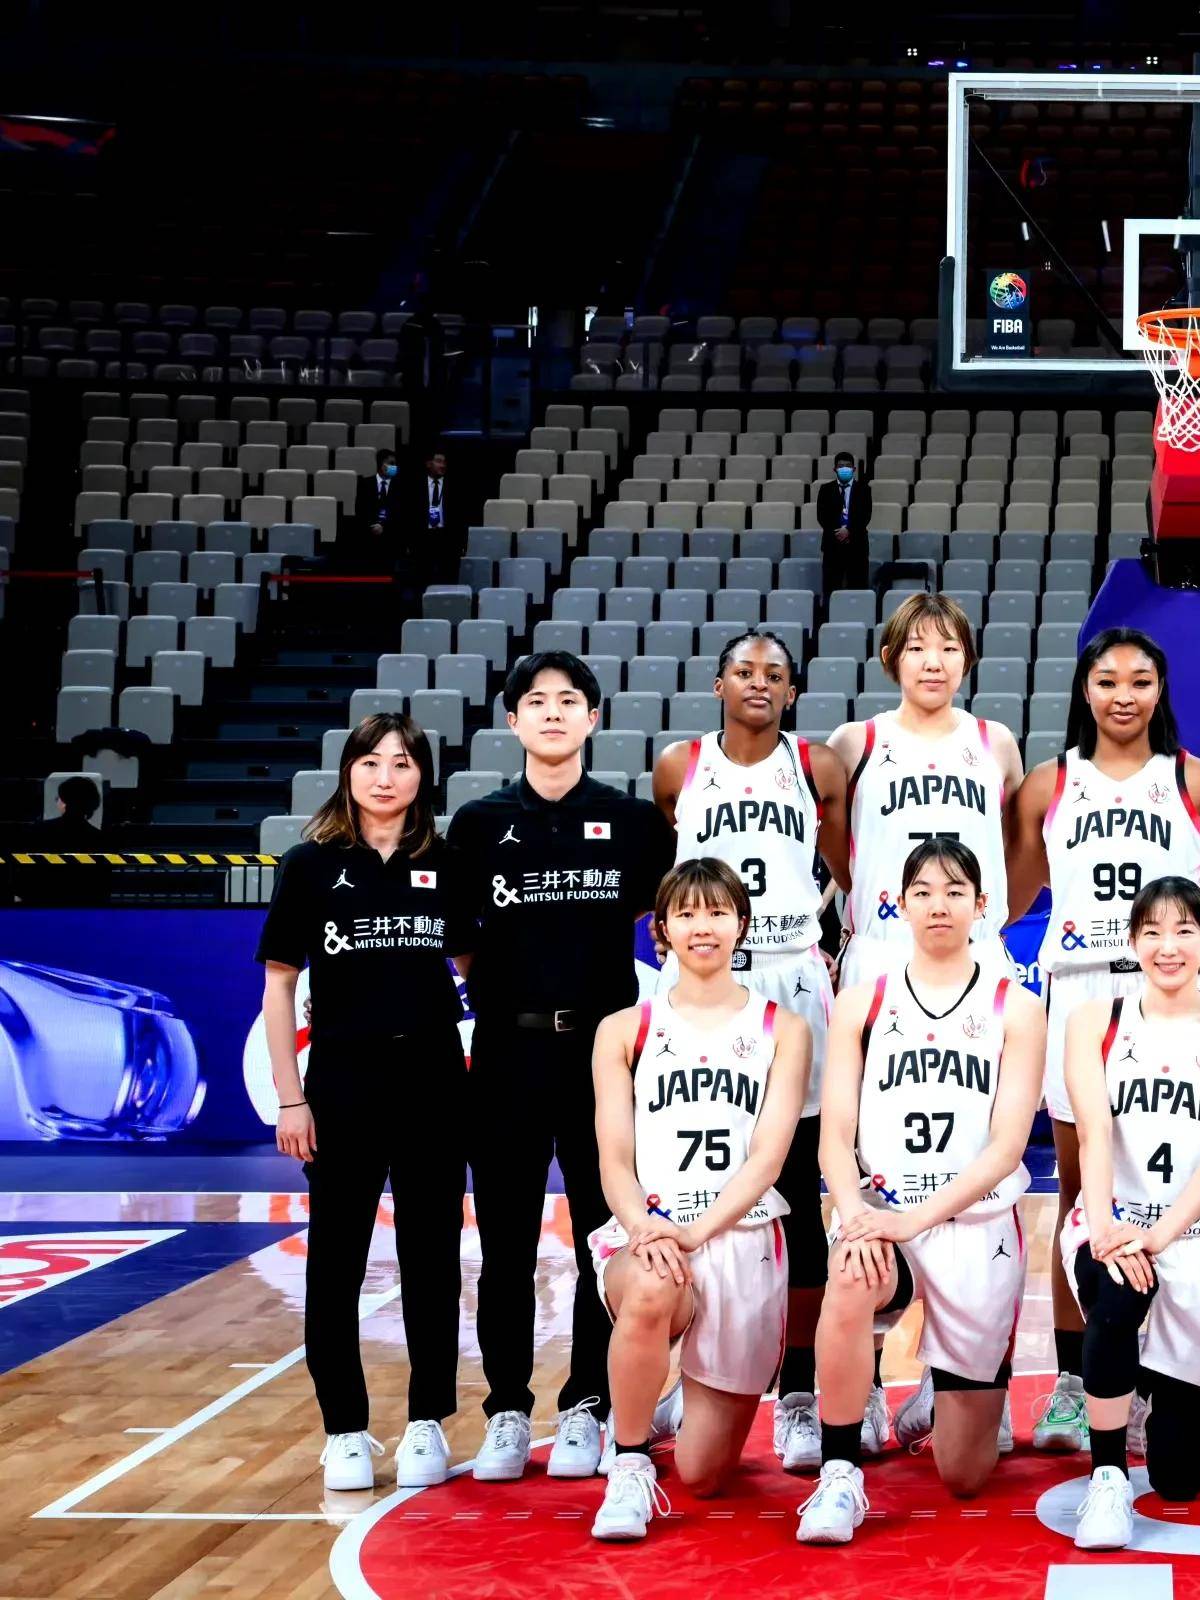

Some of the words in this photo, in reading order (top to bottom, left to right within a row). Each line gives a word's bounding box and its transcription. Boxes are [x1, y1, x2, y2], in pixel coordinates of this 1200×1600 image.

[993, 319, 1023, 334] FIBA
[881, 775, 986, 816] JAPAN
[696, 800, 804, 844] JAPAN
[1066, 808, 1171, 851] JAPAN
[523, 869, 621, 890] 三井不動産
[523, 891, 564, 903] MITSUI
[567, 890, 619, 901] FUDOSAN
[740, 858, 767, 897] 3
[1092, 862, 1142, 901] 99
[353, 915, 446, 937] 三井不動産
[355, 938, 395, 949] MITSUI
[397, 937, 444, 949] FUDOSAN
[1090, 938, 1123, 948] MITSUI
[648, 1067, 760, 1115] JAPAN
[878, 1048, 990, 1095] JAPAN
[676, 1129, 731, 1172] 75
[904, 1112, 955, 1154] 37
[1147, 1142, 1173, 1184] 4
